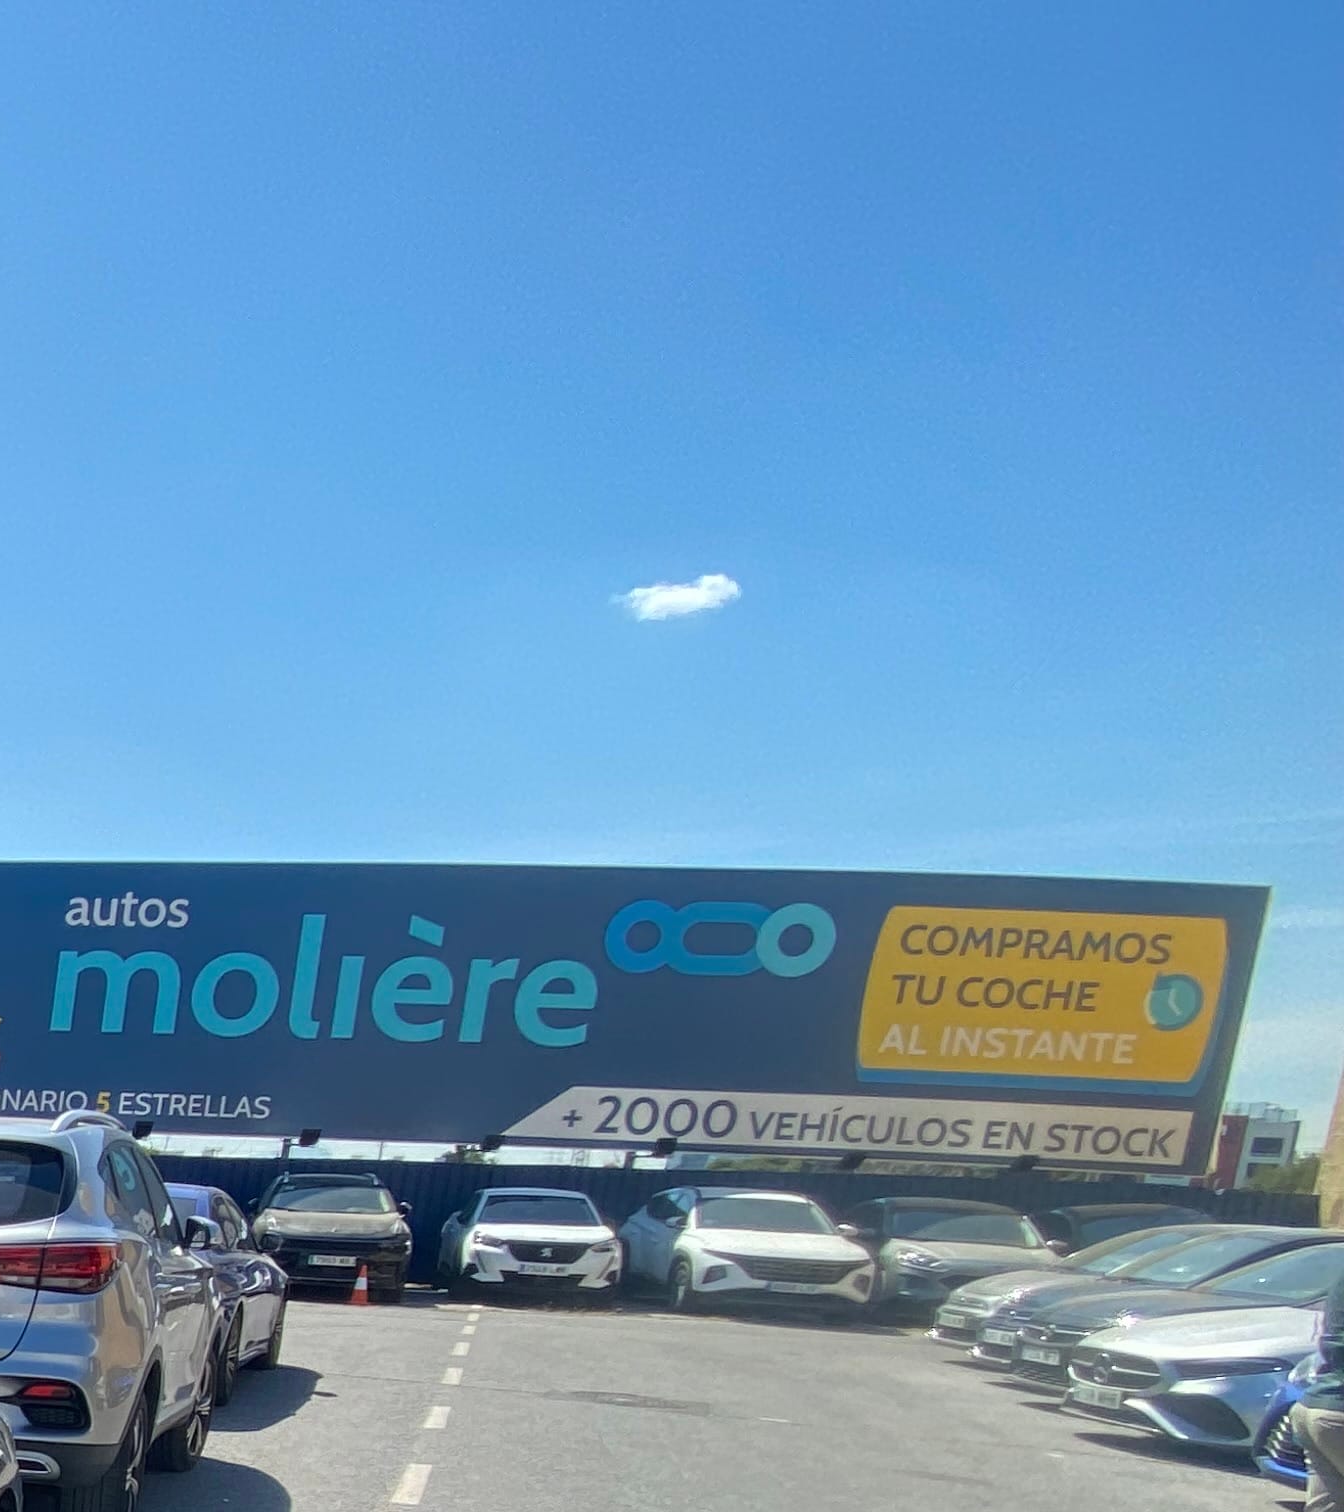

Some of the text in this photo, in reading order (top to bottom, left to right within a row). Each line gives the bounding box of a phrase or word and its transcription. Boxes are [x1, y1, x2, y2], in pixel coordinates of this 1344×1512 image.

[63, 891, 190, 929] autos
[899, 923, 1173, 965] COMPRAMOS
[891, 973, 1101, 1012] TU COCHE
[877, 1022, 1139, 1065] AL INSTANTE
[96, 1091, 111, 1113] 5
[118, 1092, 273, 1120] ESTRELLAS
[593, 1095, 738, 1139] 2000
[749, 1106, 973, 1149] VEHÍCULOS
[982, 1119, 1035, 1151] EN
[1044, 1123, 1177, 1159] STOCK
